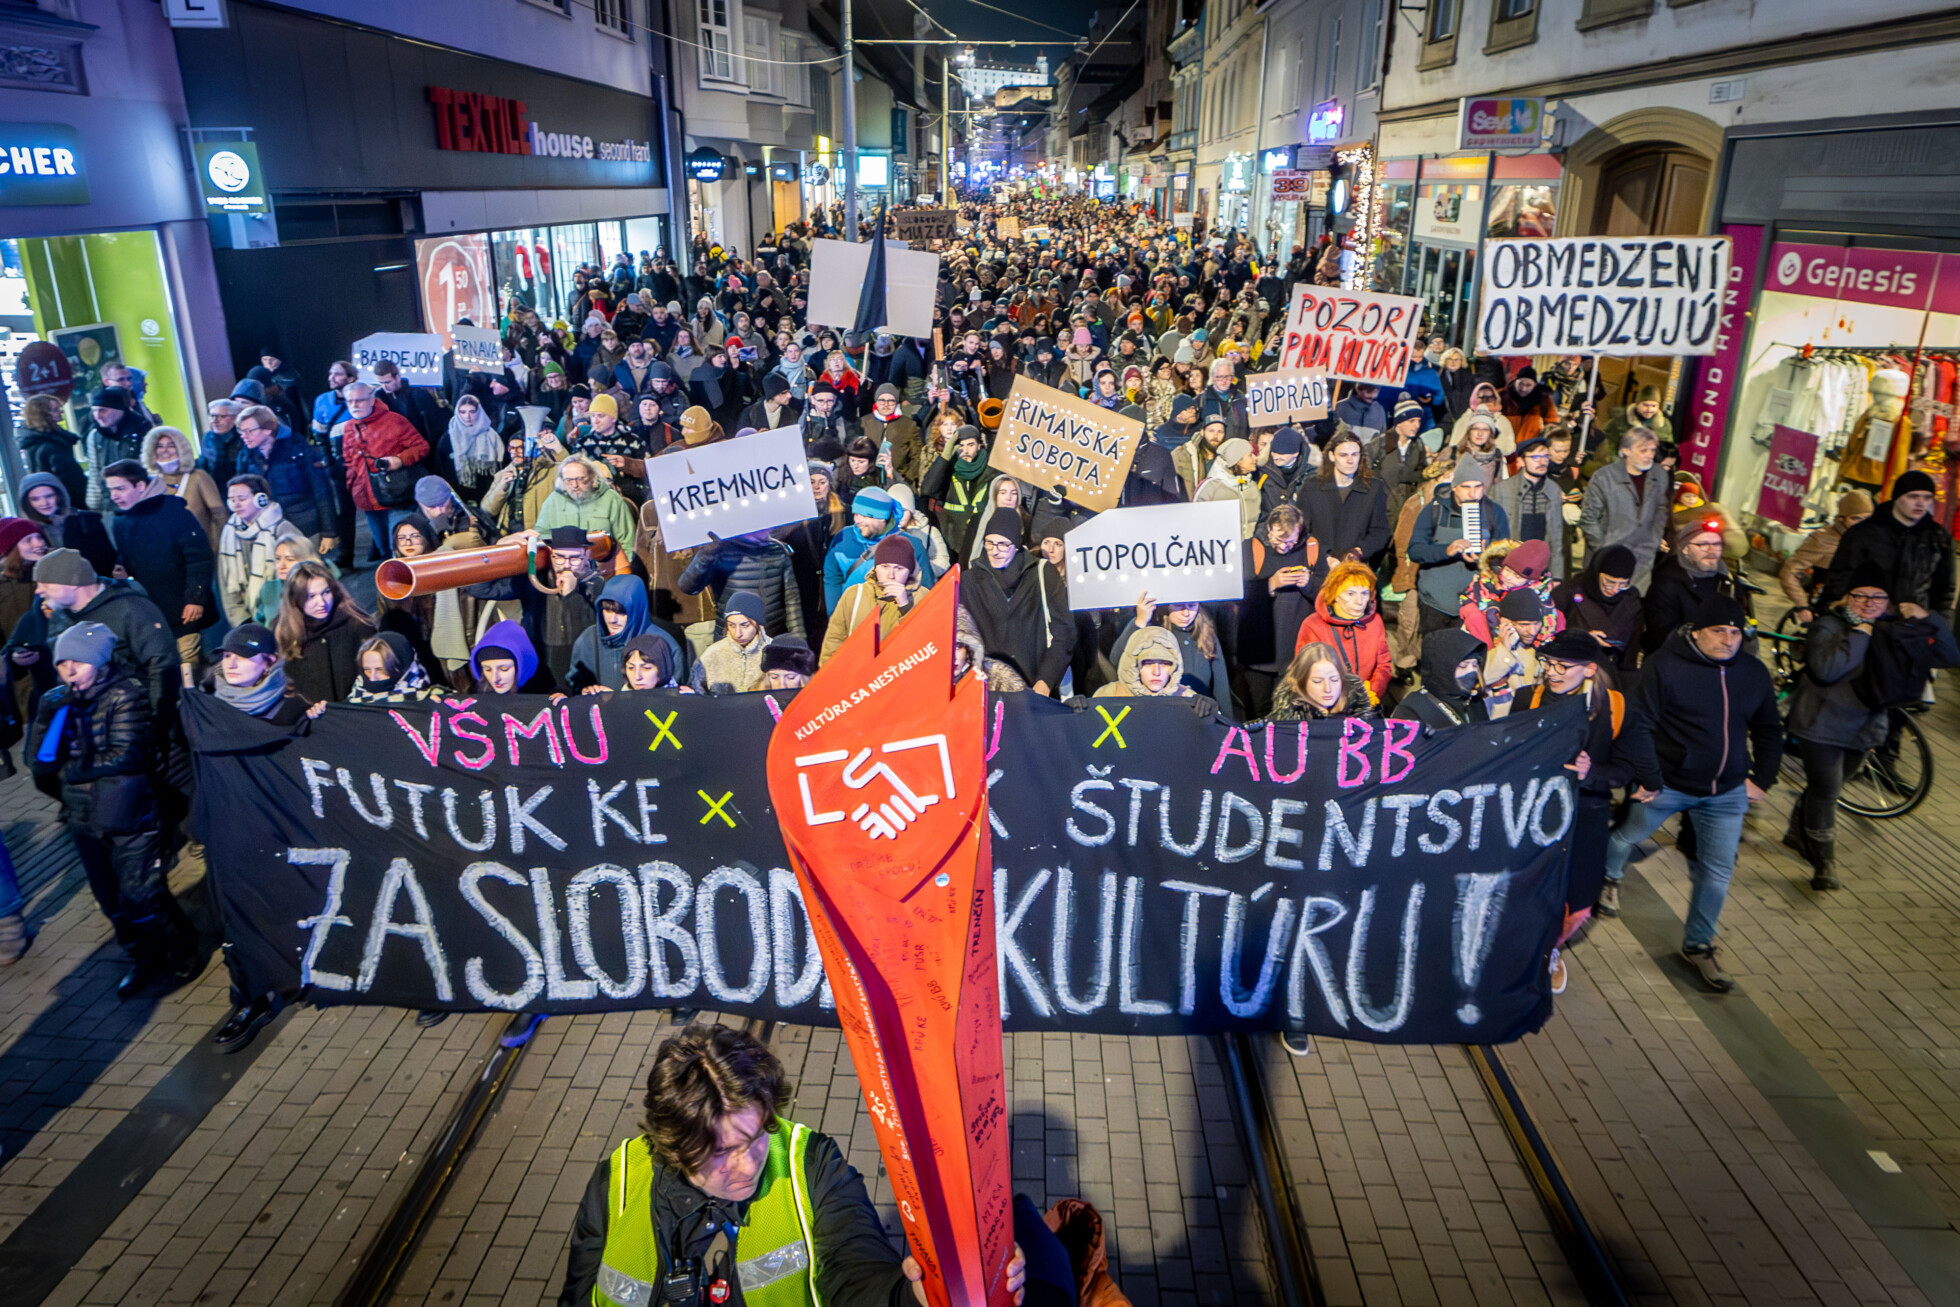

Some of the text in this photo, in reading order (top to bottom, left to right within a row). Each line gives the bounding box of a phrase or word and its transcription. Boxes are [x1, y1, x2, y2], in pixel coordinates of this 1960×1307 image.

[429, 86, 651, 163] TEXTILE house second hand
[899, 224, 957, 240] MUZEA
[1492, 240, 1724, 291] OBMEDZENÍ
[1806, 258, 1918, 295] Genesis
[1299, 293, 1420, 347] POZOR!
[1484, 292, 1718, 350] OBMEDZUJÚ
[1716, 266, 1744, 351] HAND
[28, 360, 59, 381] 2+1
[454, 338, 499, 359] TRNAVA
[1281, 332, 1333, 371] PADÁ
[1250, 382, 1324, 415] POPRAD
[1013, 397, 1125, 463] RIMAVSKÁ
[667, 463, 798, 516] KREMNICA
[1014, 436, 1102, 490] SOBOTA
[1076, 534, 1232, 574] TOPOLČANY
[794, 700, 852, 741] KULTÚRA
[850, 688, 870, 705] SA
[869, 641, 938, 693] NESŤAHUJE
[388, 696, 608, 770] VŠMU
[1210, 724, 1309, 784] AU
[1337, 716, 1421, 788] BB
[588, 777, 668, 847] KE
[1065, 762, 1575, 871] ŠTUDENTSTVO
[288, 847, 454, 1001] ZA
[458, 860, 836, 1011] SLOBOD
[993, 864, 1426, 1033] KULTÚRU
[971, 889, 985, 958] TRENČÍN
